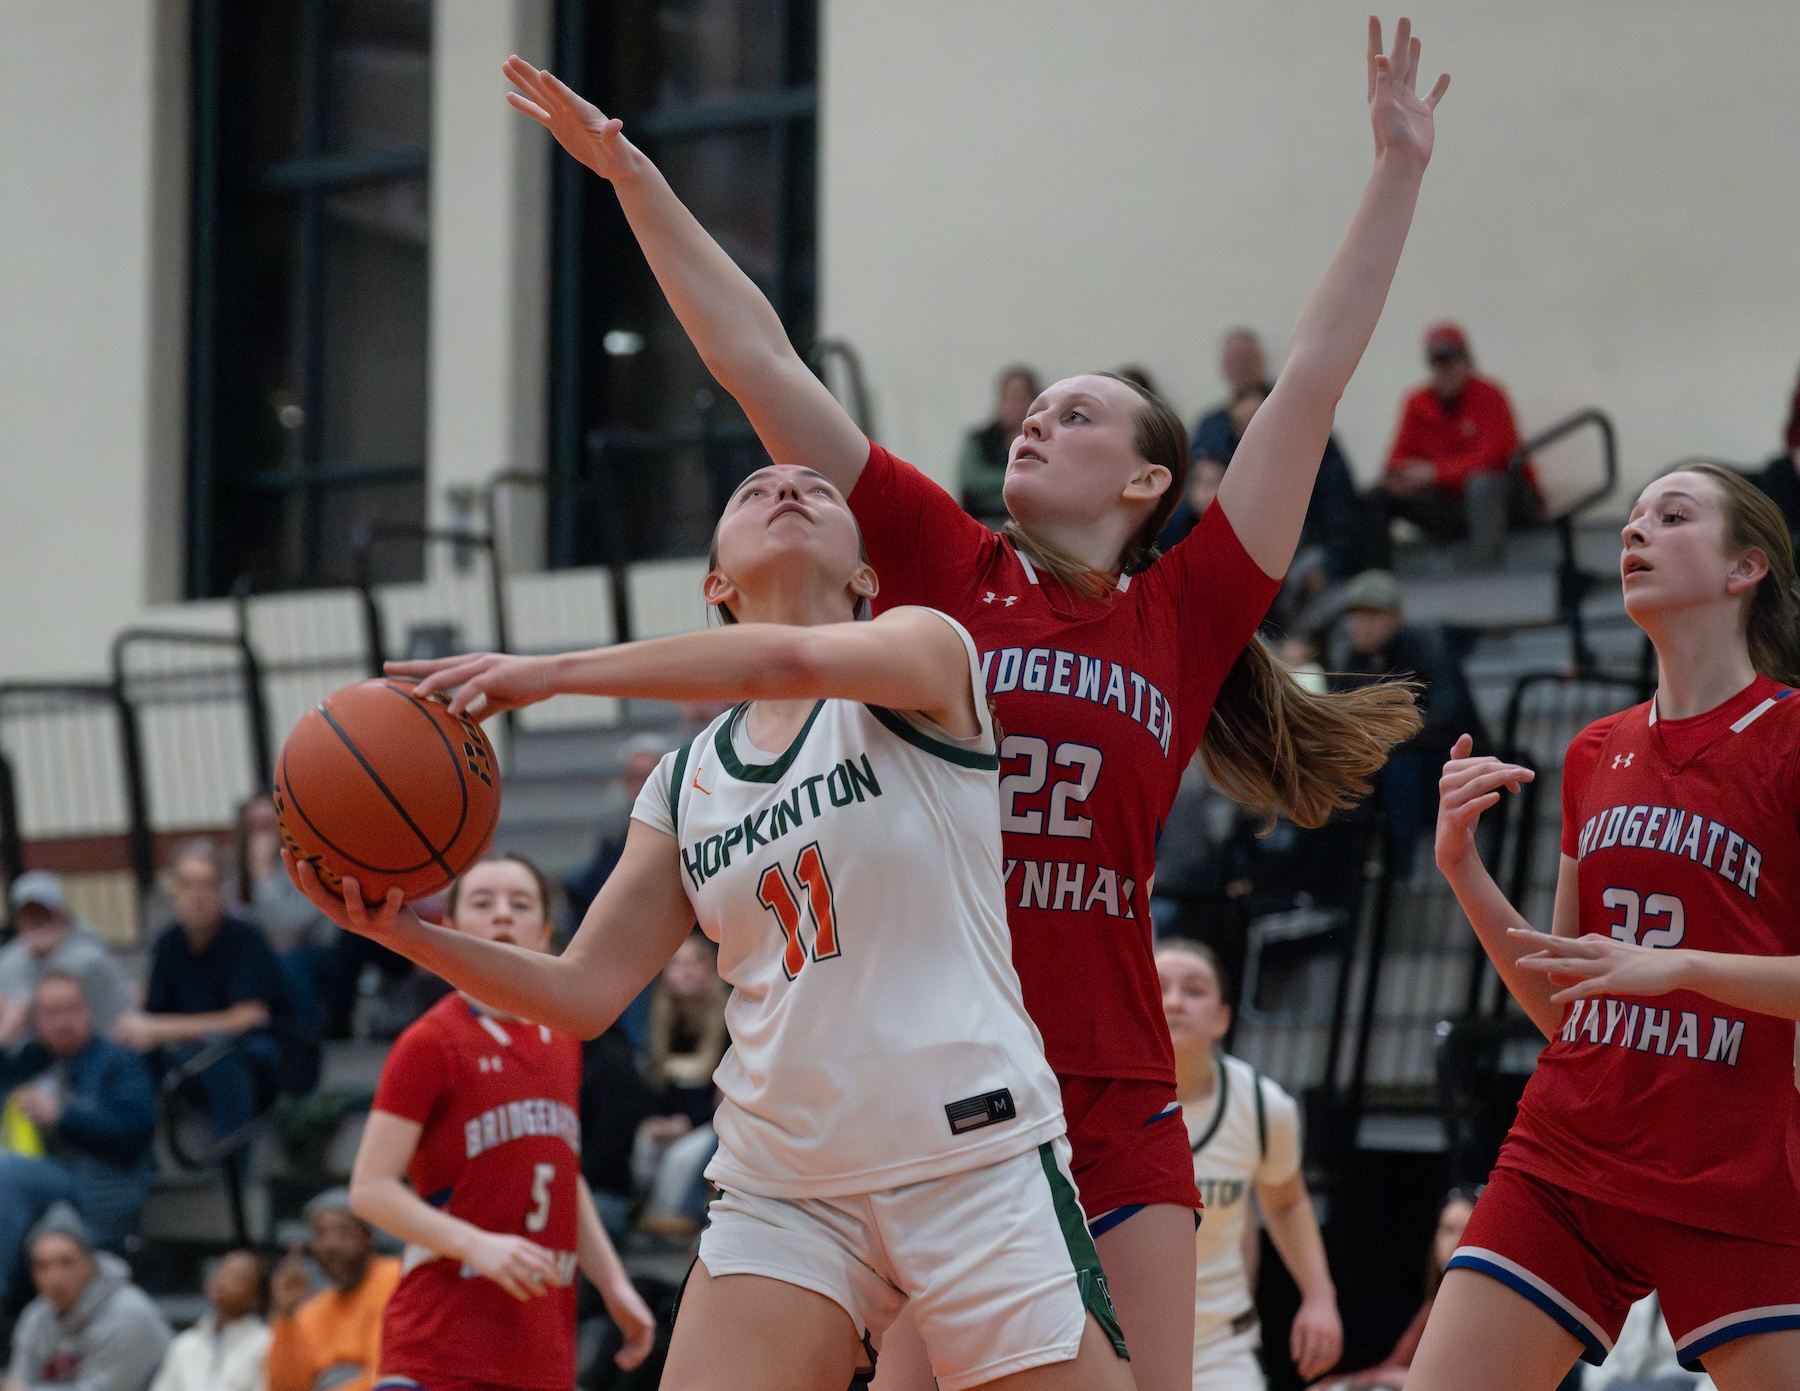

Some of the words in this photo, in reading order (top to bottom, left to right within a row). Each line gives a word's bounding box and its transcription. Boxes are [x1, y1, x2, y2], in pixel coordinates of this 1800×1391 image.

[979, 646, 1173, 759] IDGEWATER
[681, 752, 883, 893] HOPKINTON
[1000, 733, 1104, 839] 22
[1577, 803, 1763, 900] BRIDGEWATER
[756, 840, 842, 982] 11
[1602, 886, 1686, 949] 32
[993, 1097, 1008, 1114] M
[524, 1162, 557, 1233] 5
